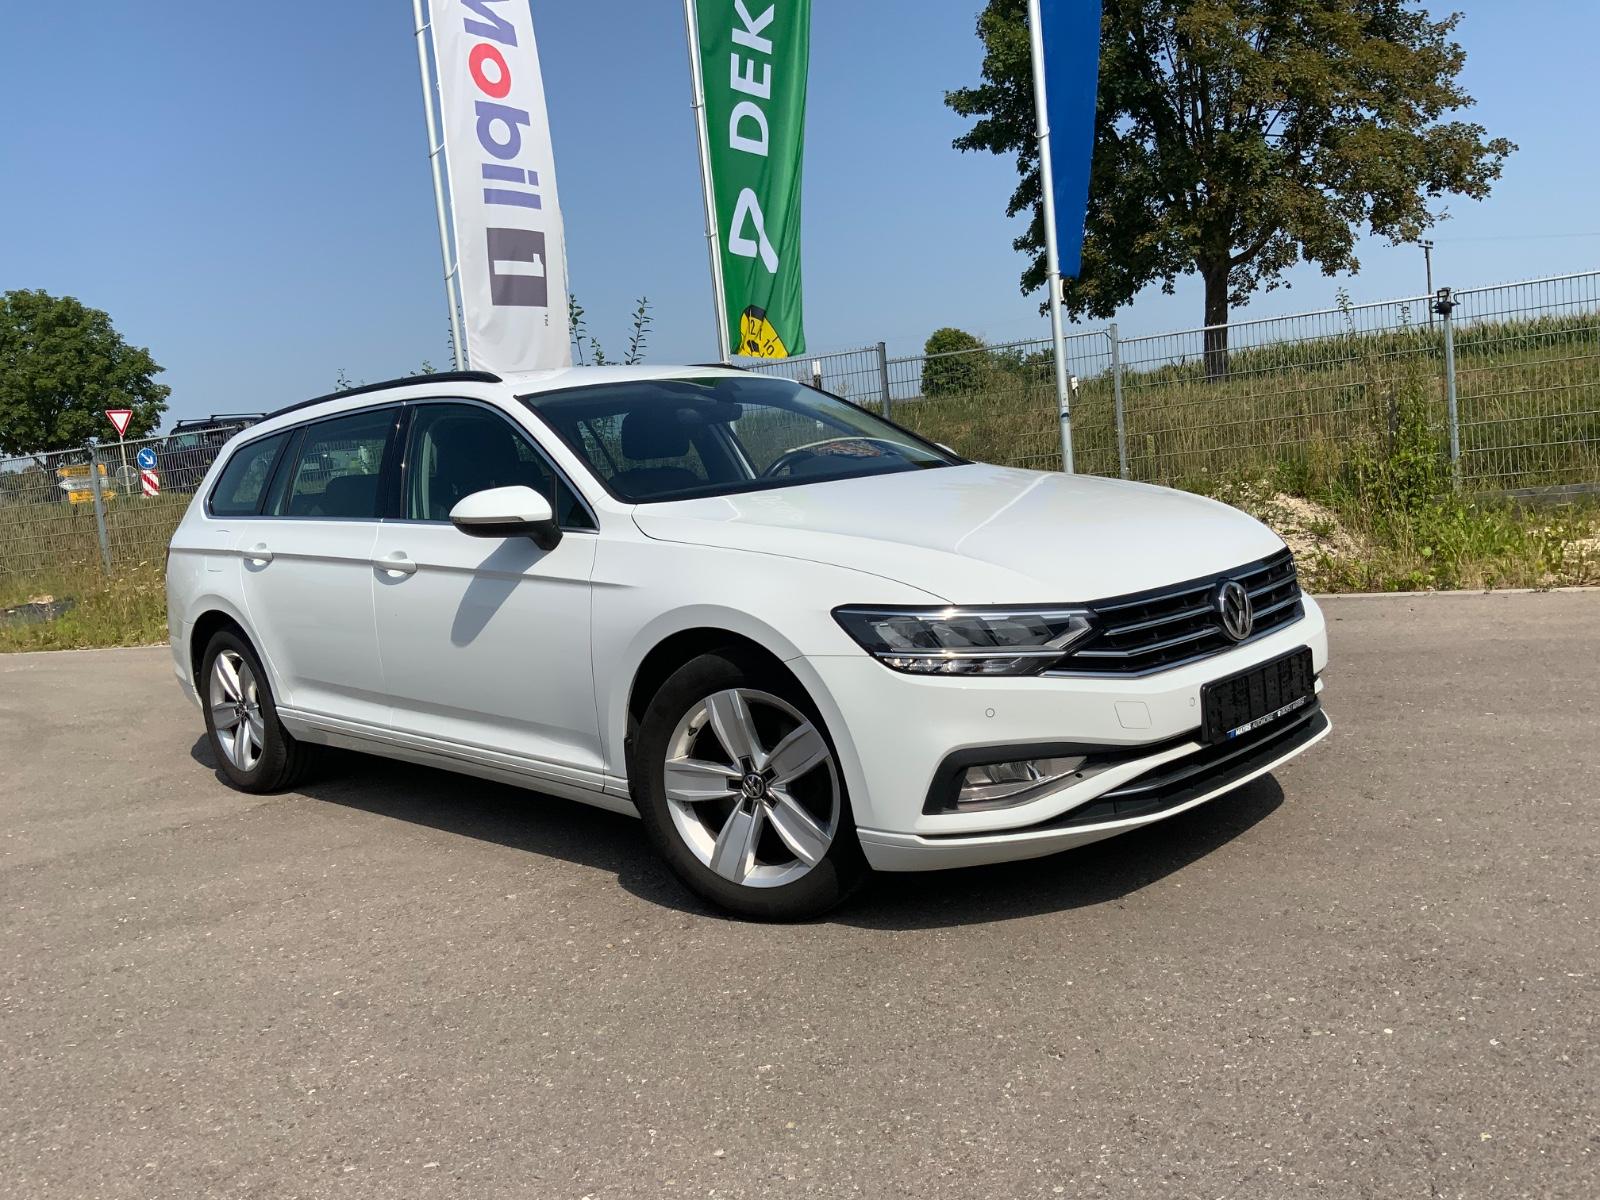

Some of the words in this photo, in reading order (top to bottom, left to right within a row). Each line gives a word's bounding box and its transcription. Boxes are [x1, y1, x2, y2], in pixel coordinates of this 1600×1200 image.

[460, 0, 542, 210] Mobil
[493, 254, 545, 277] 1
[763, 339, 775, 356] 10
